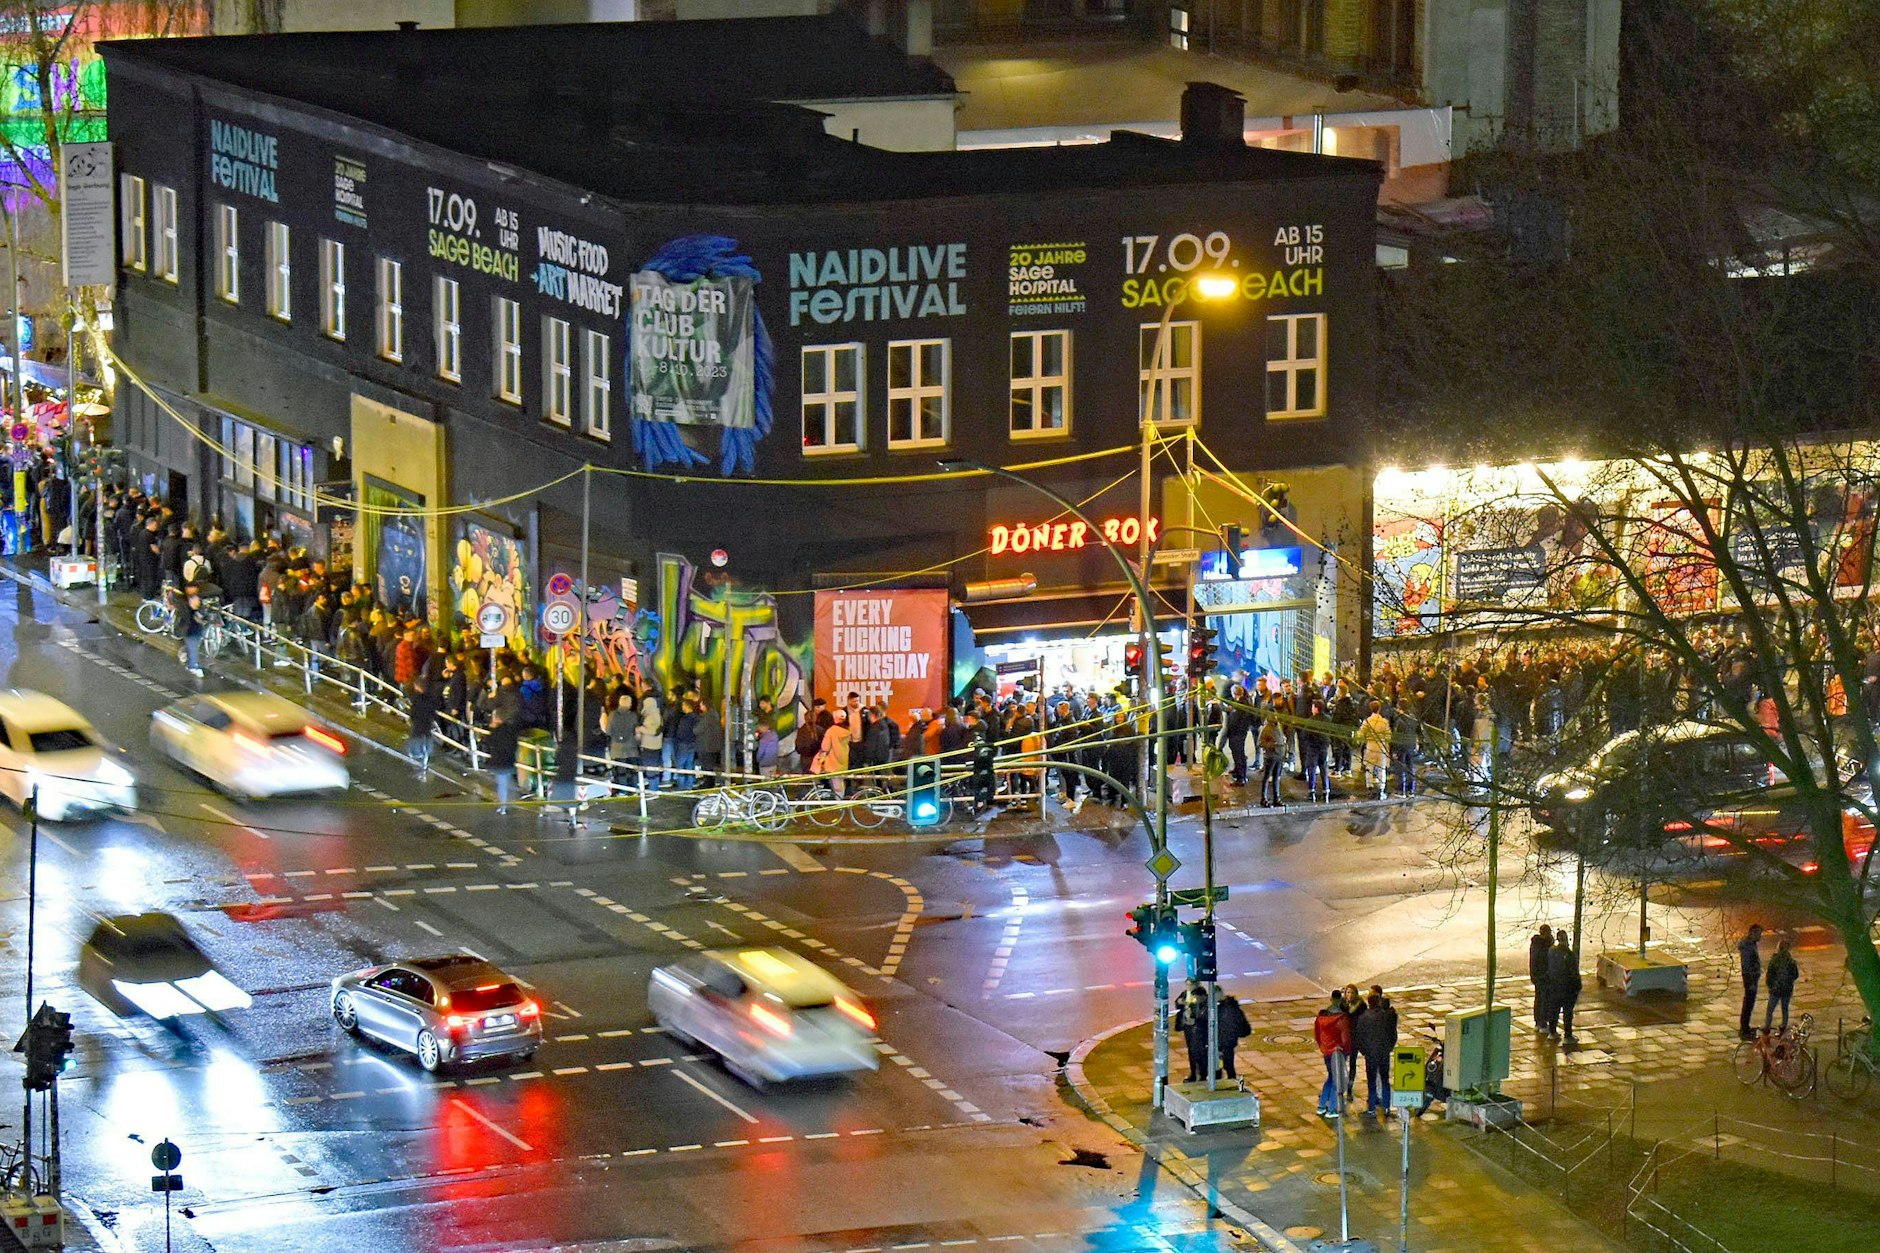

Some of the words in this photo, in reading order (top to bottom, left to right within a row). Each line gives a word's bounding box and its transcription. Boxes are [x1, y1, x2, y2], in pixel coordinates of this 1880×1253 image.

[211, 119, 278, 169] NAIDLIVE
[427, 186, 481, 239] 17.09.
[495, 207, 508, 228] AB
[509, 212, 519, 232] 15
[500, 228, 519, 251] UHR
[1274, 226, 1300, 246] AB
[1305, 225, 1324, 244] 15
[537, 226, 577, 269] MUSIC
[578, 239, 609, 276] FOOD
[1009, 252, 1033, 267] 20
[1121, 231, 1240, 275] 17.09.
[1285, 245, 1324, 266] UHR
[789, 243, 967, 288] NAIDLIVE
[567, 270, 624, 321] MARKET
[1009, 279, 1077, 296] HOSPITAL
[1223, 267, 1323, 301] eACH
[638, 284, 675, 313] TAG
[681, 289, 726, 314] DER
[1054, 302, 1086, 314] HILFT!
[637, 309, 695, 337] CLUB
[637, 334, 721, 364] KULTUR
[991, 521, 1087, 555] DÖNER
[1102, 516, 1159, 547] BOX
[550, 609, 570, 625] 30
[832, 599, 893, 626] EVERY
[832, 626, 912, 653] FUCKING
[833, 653, 930, 680] THURSDAY
